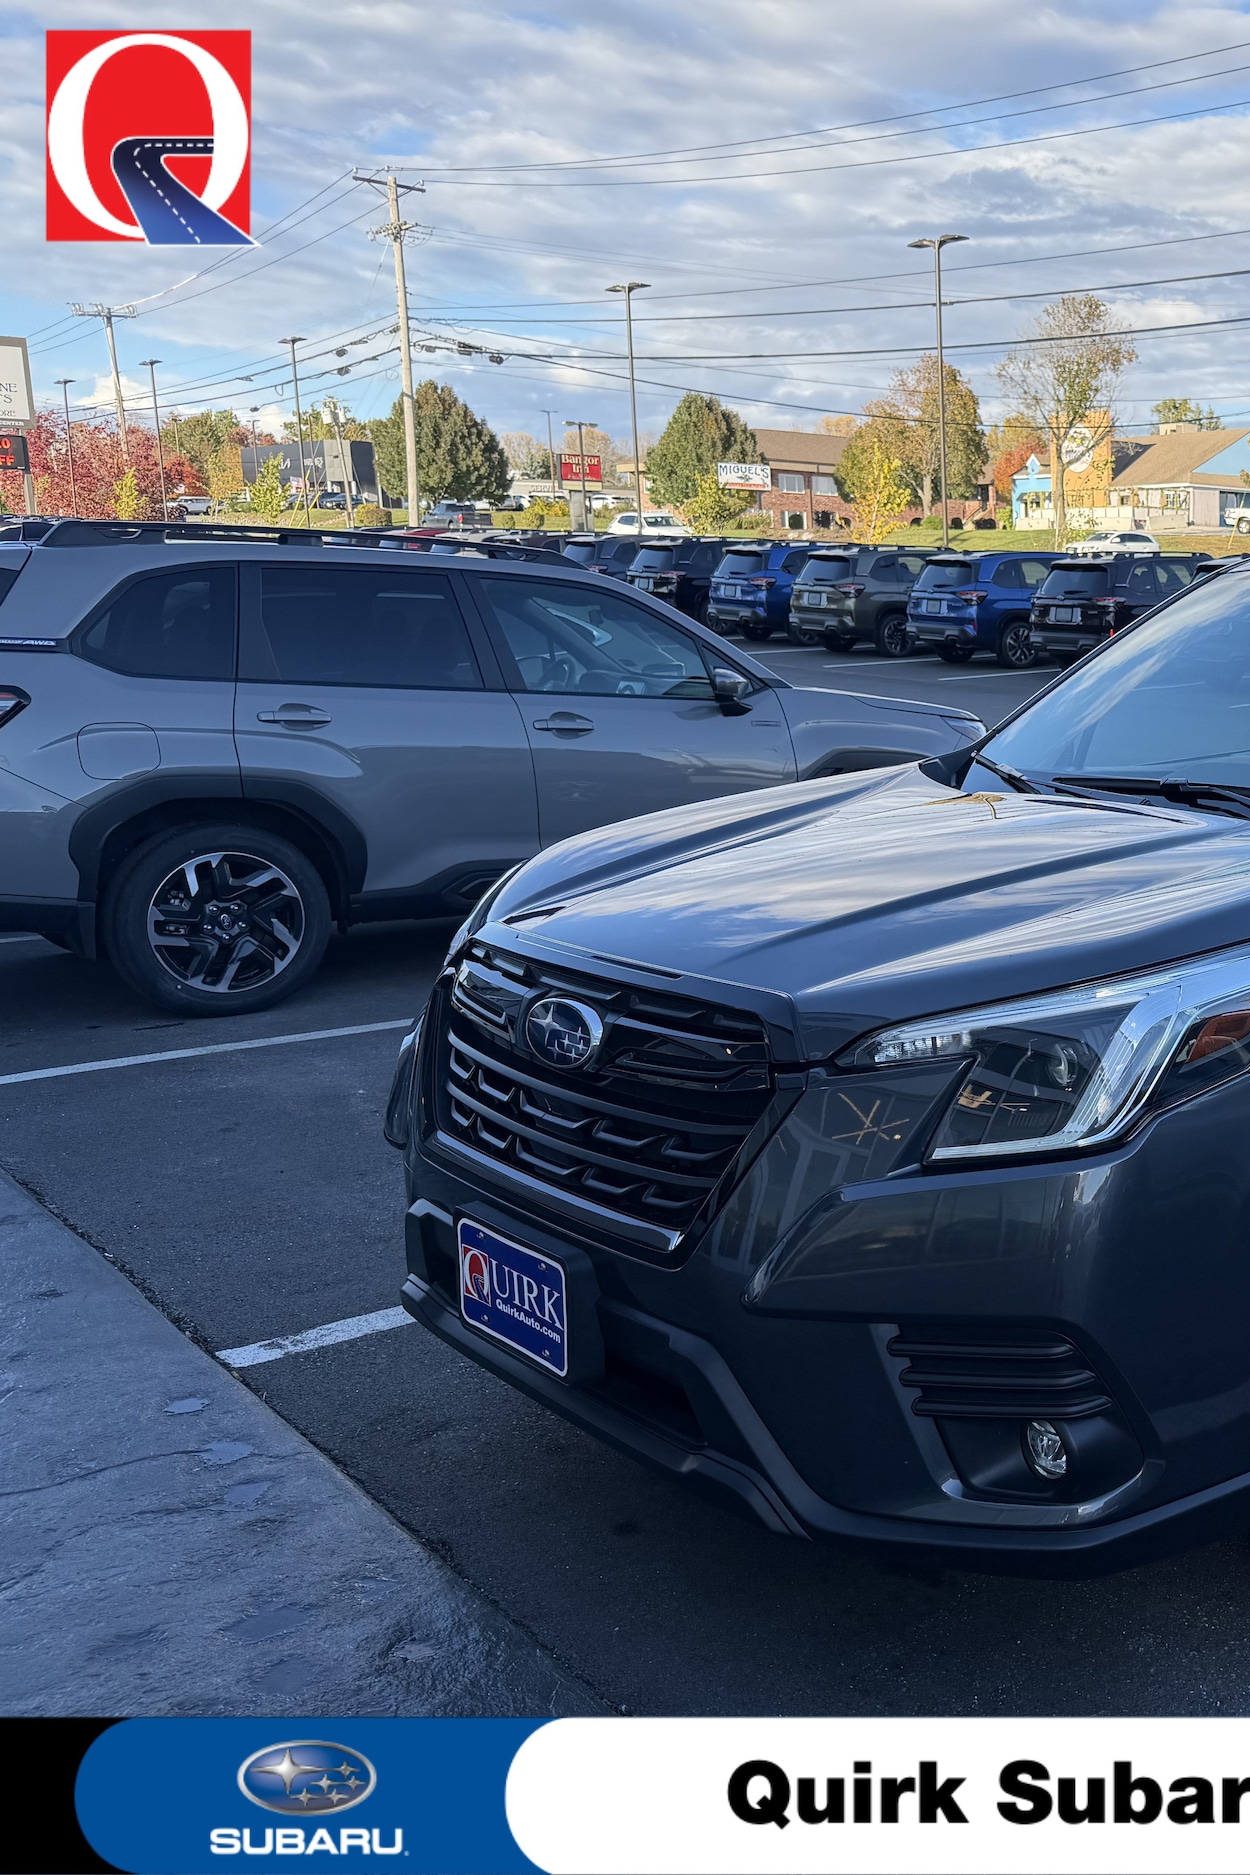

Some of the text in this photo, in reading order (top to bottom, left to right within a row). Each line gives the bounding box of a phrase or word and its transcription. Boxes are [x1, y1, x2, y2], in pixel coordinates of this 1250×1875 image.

[561, 455, 599, 466] Bangor
[572, 464, 590, 475] Inn
[464, 1250, 564, 1331] QUIRK
[495, 1298, 561, 1344] QuirkAuto.com
